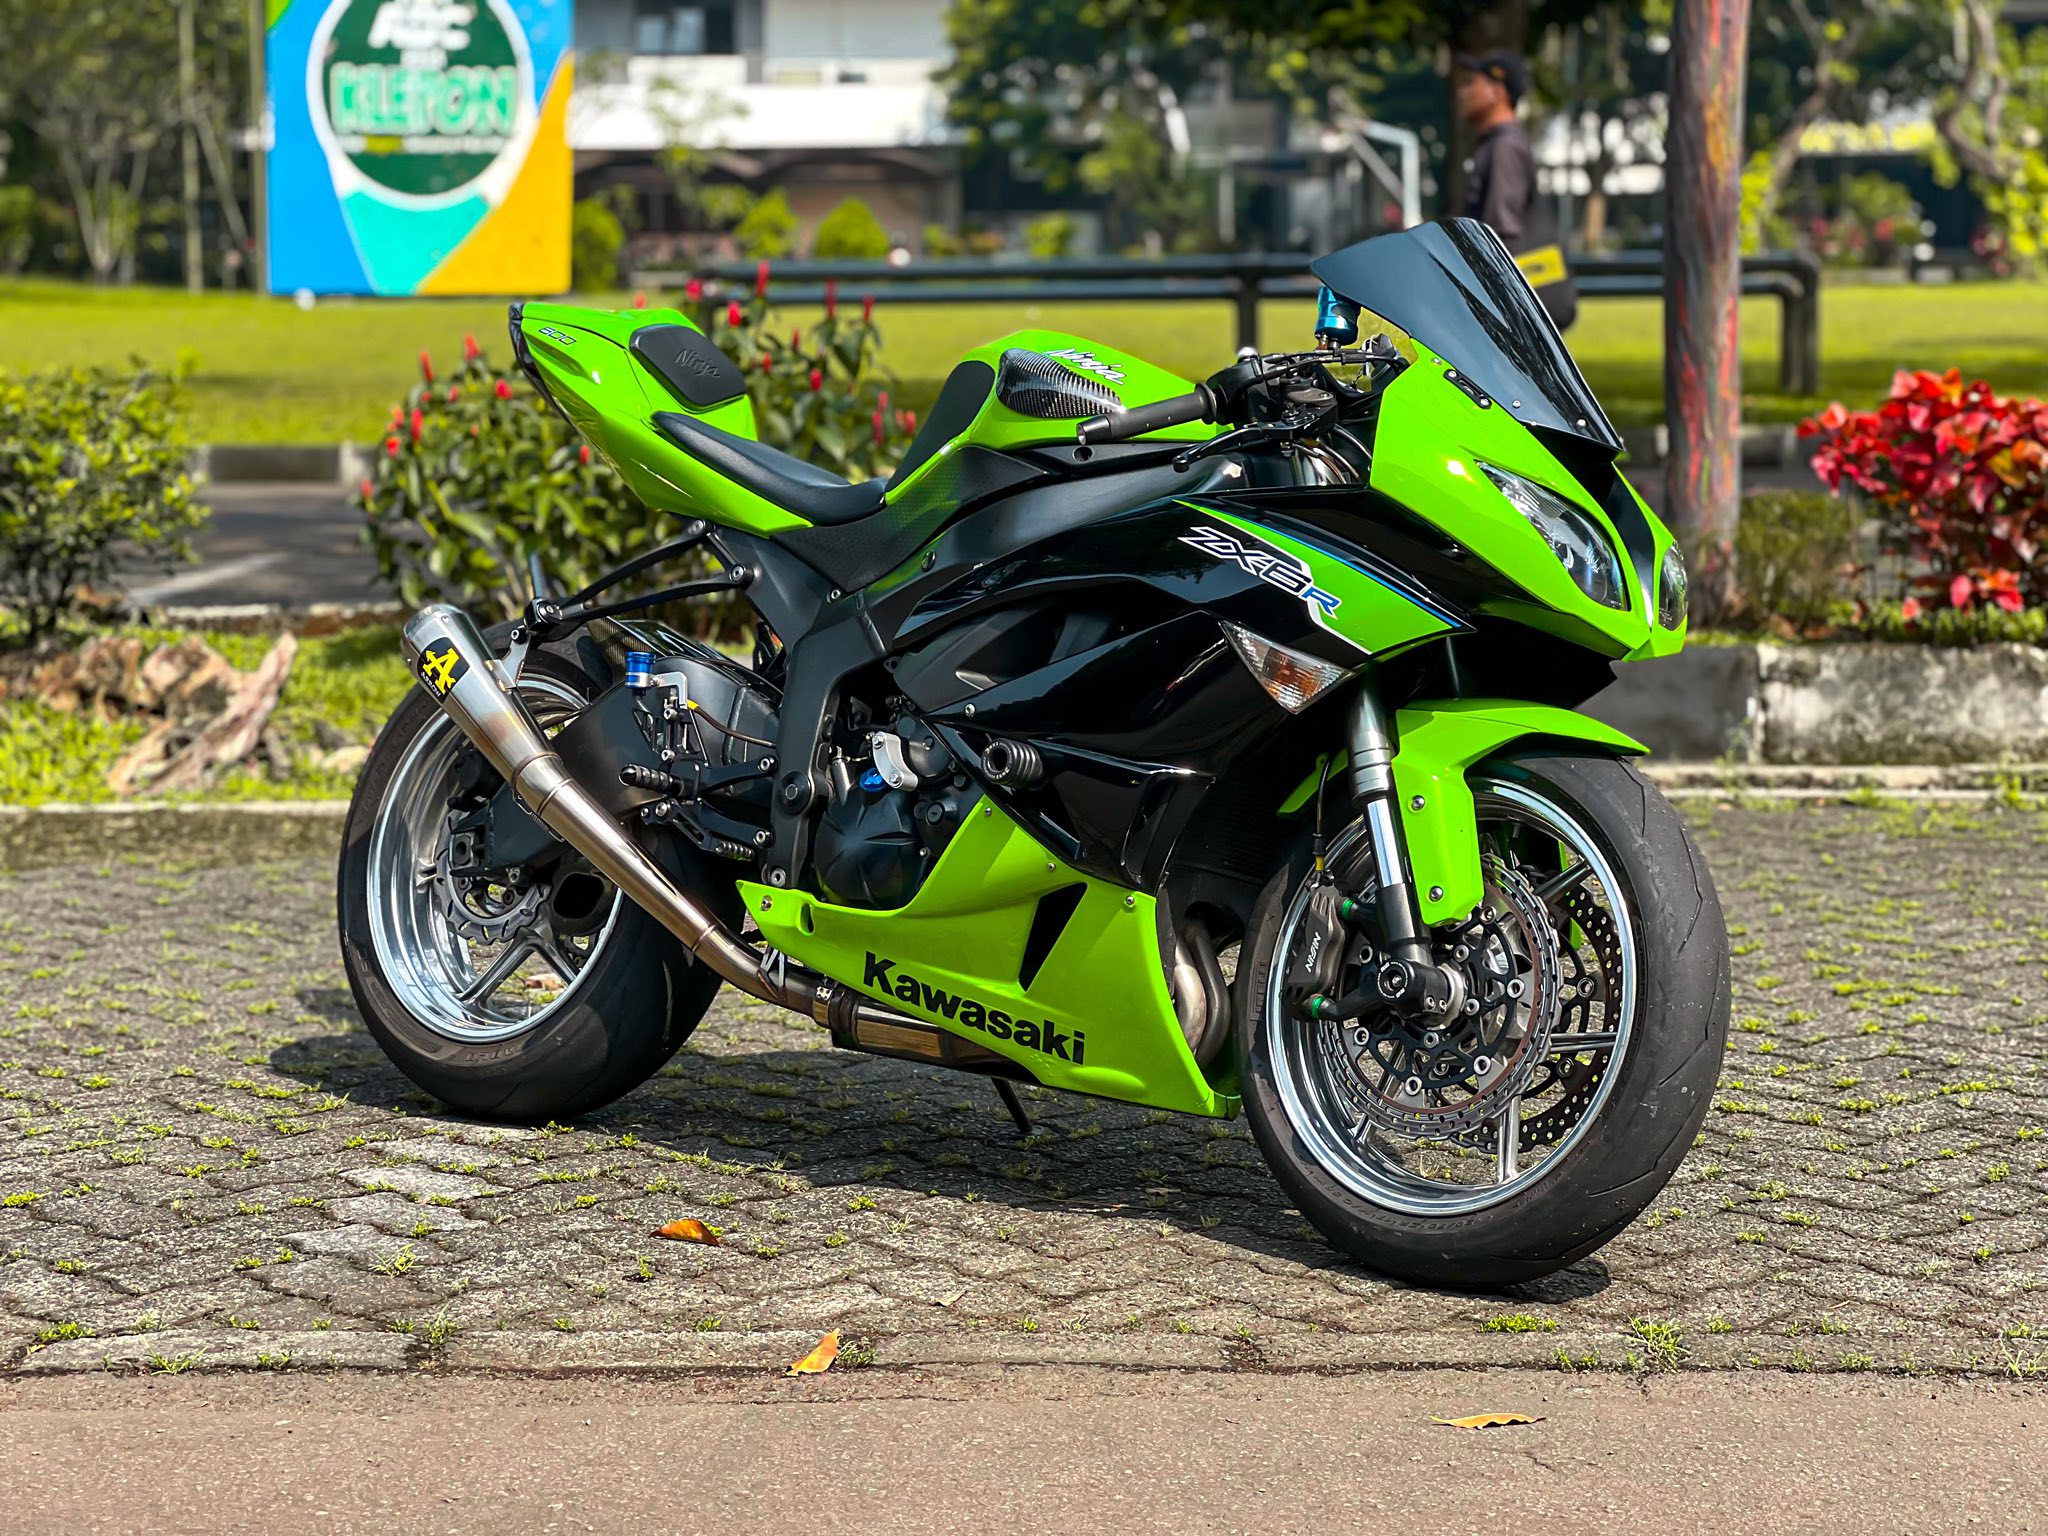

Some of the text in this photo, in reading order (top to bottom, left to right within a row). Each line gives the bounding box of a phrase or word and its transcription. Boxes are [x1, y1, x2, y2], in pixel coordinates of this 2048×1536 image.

[675, 348, 720, 377] Ninja
[1044, 348, 1126, 385] Ninja
[863, 950, 1085, 1065] Kawasaki
